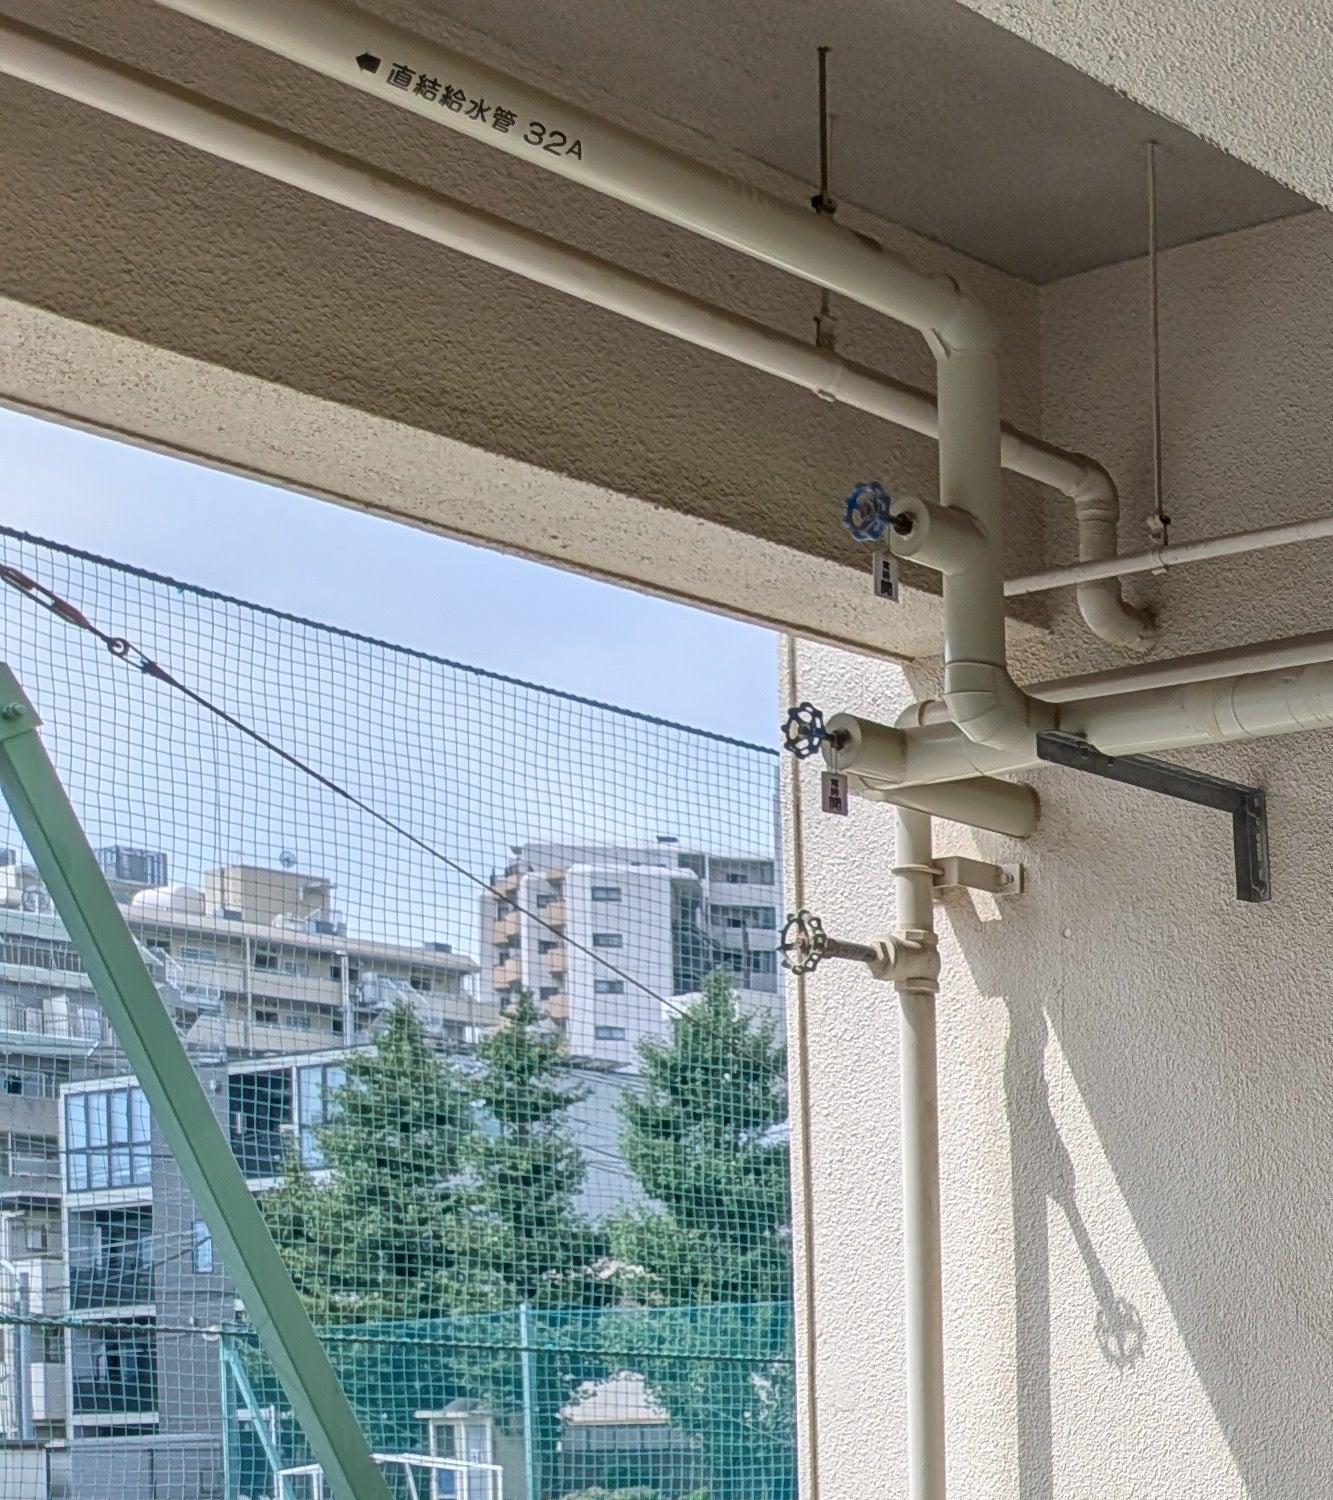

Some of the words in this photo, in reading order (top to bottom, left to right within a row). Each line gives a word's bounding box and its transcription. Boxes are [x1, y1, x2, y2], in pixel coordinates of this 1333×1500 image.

[387, 62, 518, 134] 直結給水管
[524, 121, 583, 161] 32A
